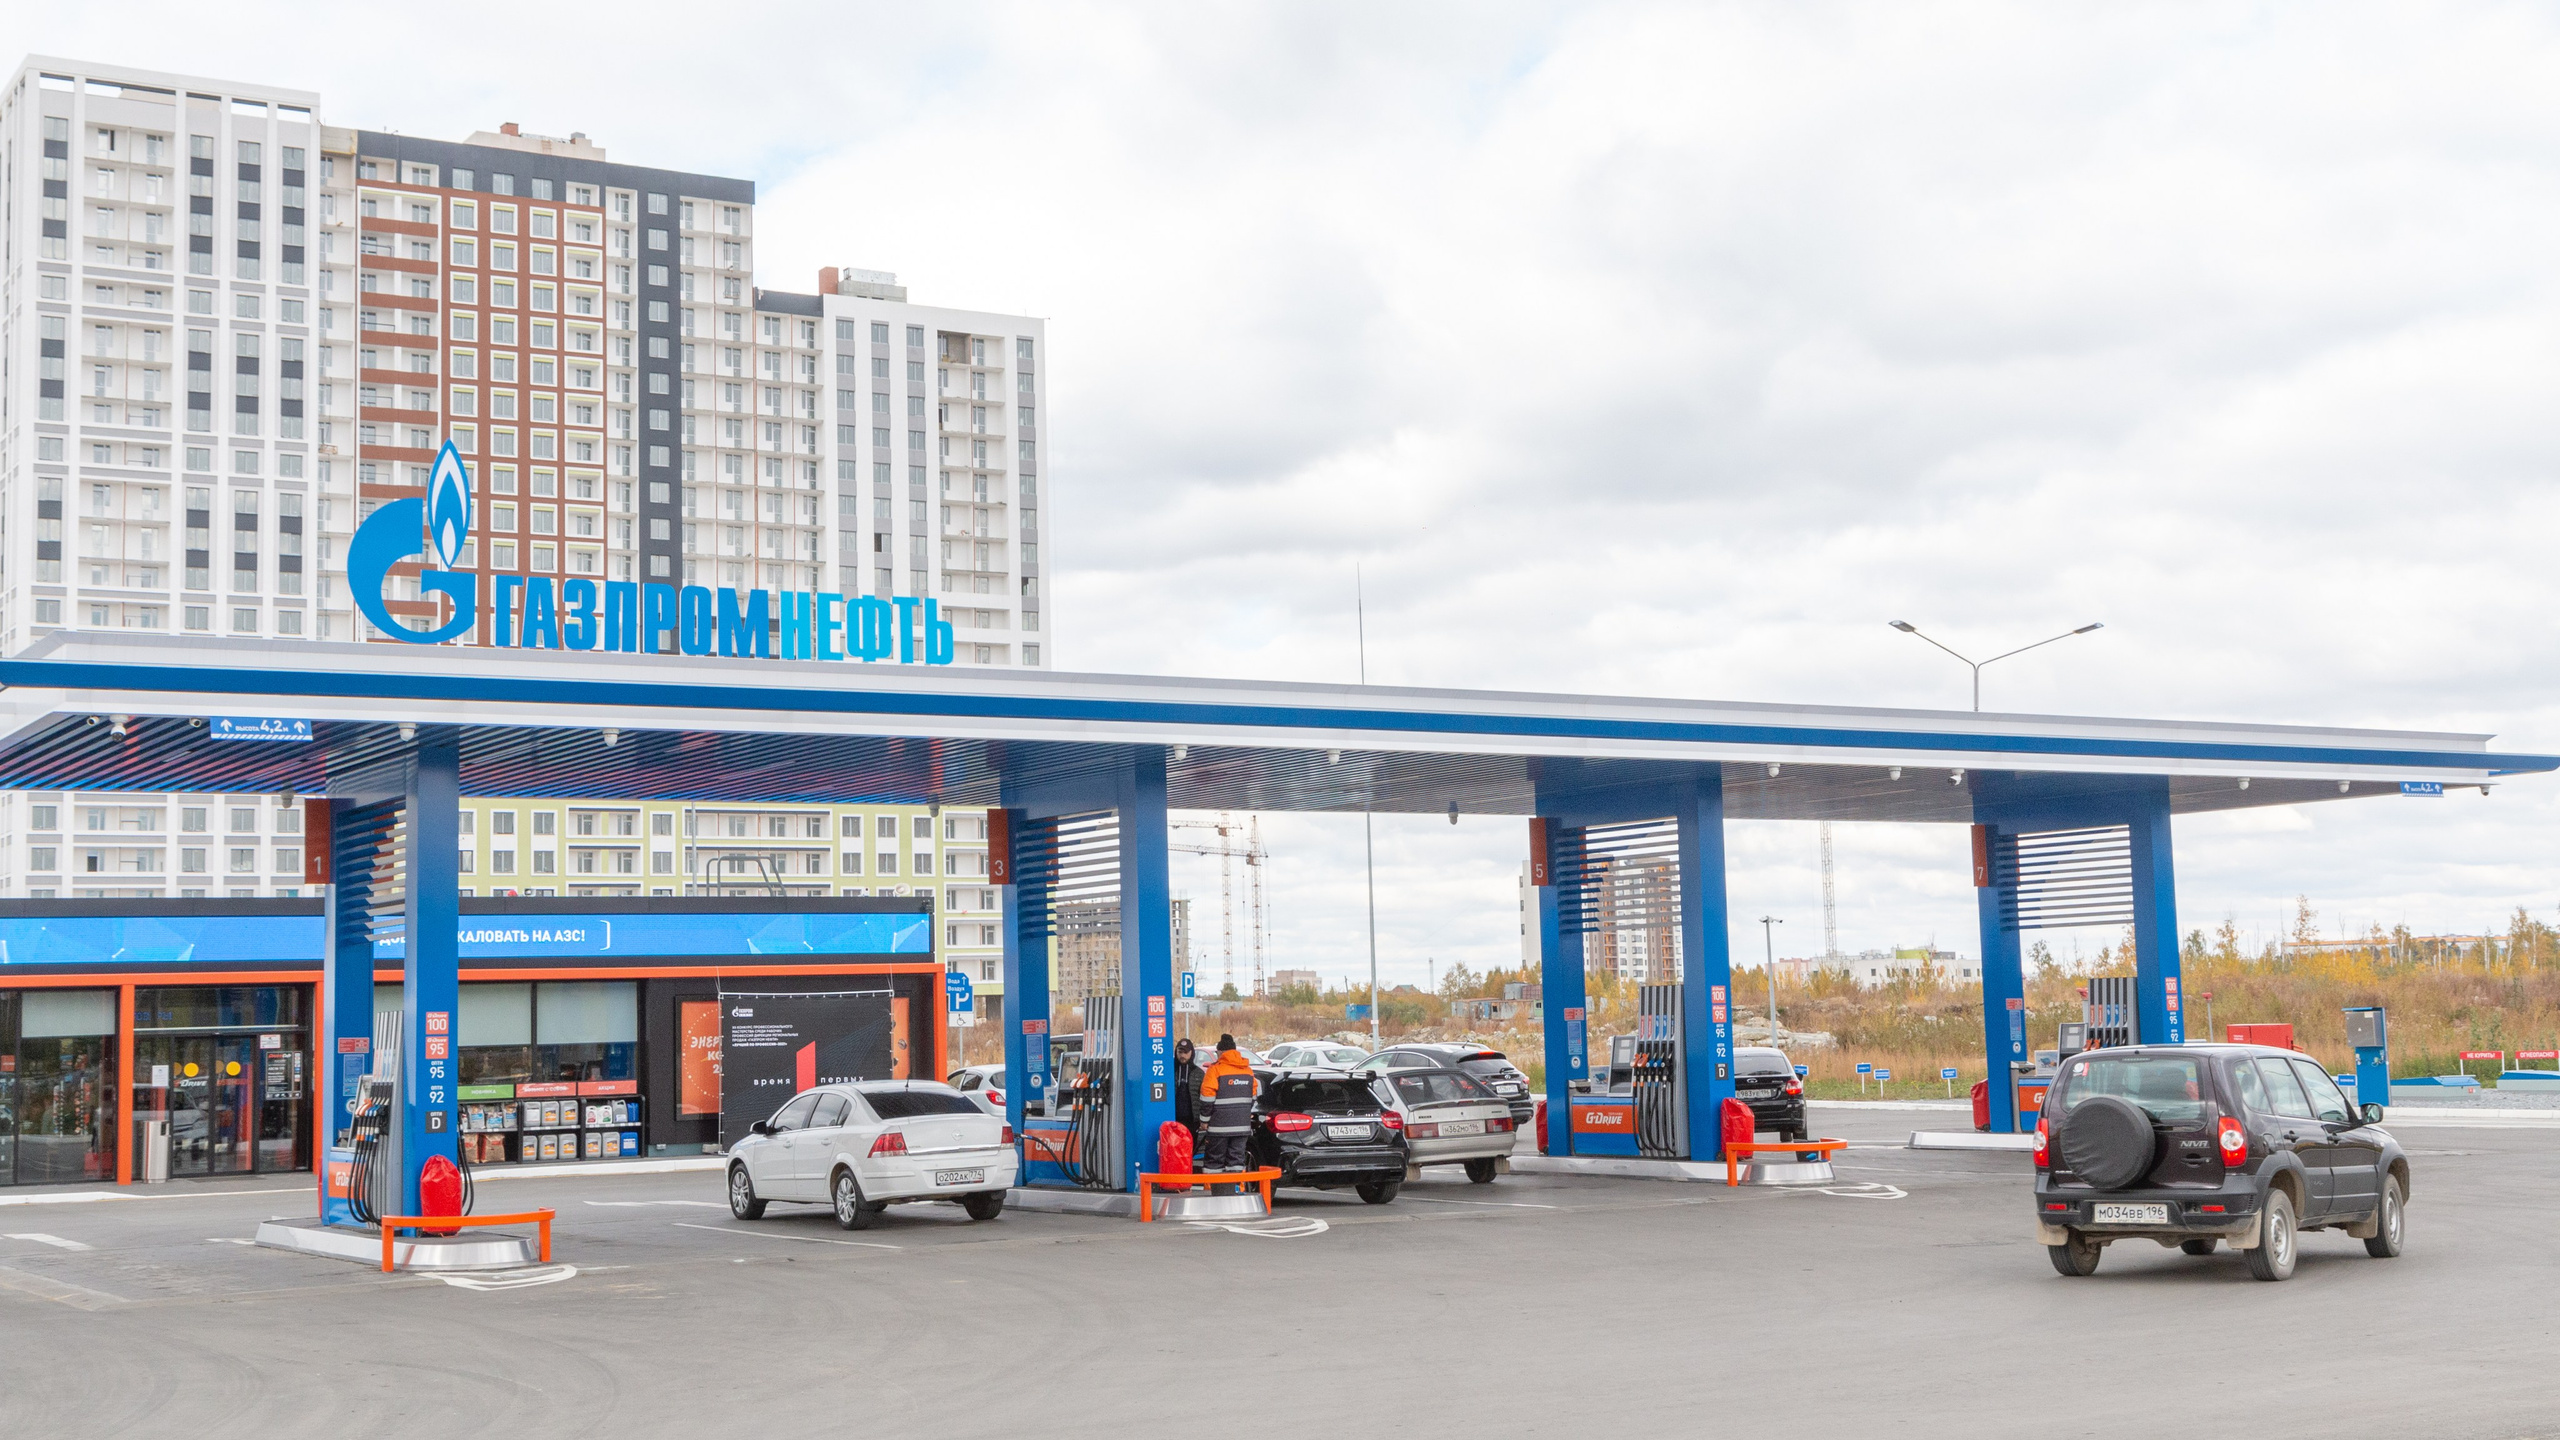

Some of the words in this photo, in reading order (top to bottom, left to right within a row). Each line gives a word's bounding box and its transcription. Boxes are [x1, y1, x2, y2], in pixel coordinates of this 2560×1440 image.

[494, 575, 954, 665] ГАЗПРОМНЕФТЬ
[260, 719, 283, 734] 4,2
[313, 856, 322, 875] 1
[994, 860, 1004, 877] 3
[1535, 863, 1544, 879] 5
[1977, 866, 1984, 880] 7
[533, 930, 552, 943] НА
[554, 929, 585, 942] АЗС!
[1184, 974, 1193, 996] P
[1712, 991, 1724, 999] 100
[1149, 1002, 1164, 1013] 100
[1181, 1001, 1190, 1009] 30
[1714, 1010, 1724, 1020] 95
[2169, 1015, 2178, 1024] 95
[427, 1019, 447, 1031] 100
[1151, 1023, 1163, 1034] 95
[1715, 1028, 1725, 1038] 95
[2170, 1033, 2179, 1042] 92
[430, 1043, 445, 1055] 95
[1152, 1043, 1164, 1055] 95
[1716, 1047, 1726, 1057] 92
[429, 1066, 445, 1079] 95
[1152, 1065, 1164, 1076] 92
[1718, 1068, 1725, 1078] D
[753, 1078, 791, 1087] время
[820, 1076, 864, 1084] первых
[429, 1091, 445, 1104] 92
[1154, 1088, 1162, 1099] D
[431, 1117, 441, 1130] D
[1330, 1125, 1358, 1135] Н743УС
[938, 1172, 969, 1182] О202АК
[969, 1169, 982, 1178] 774
[2099, 1206, 2143, 1219] М034ВВ
[2145, 1206, 2164, 1216] 196
